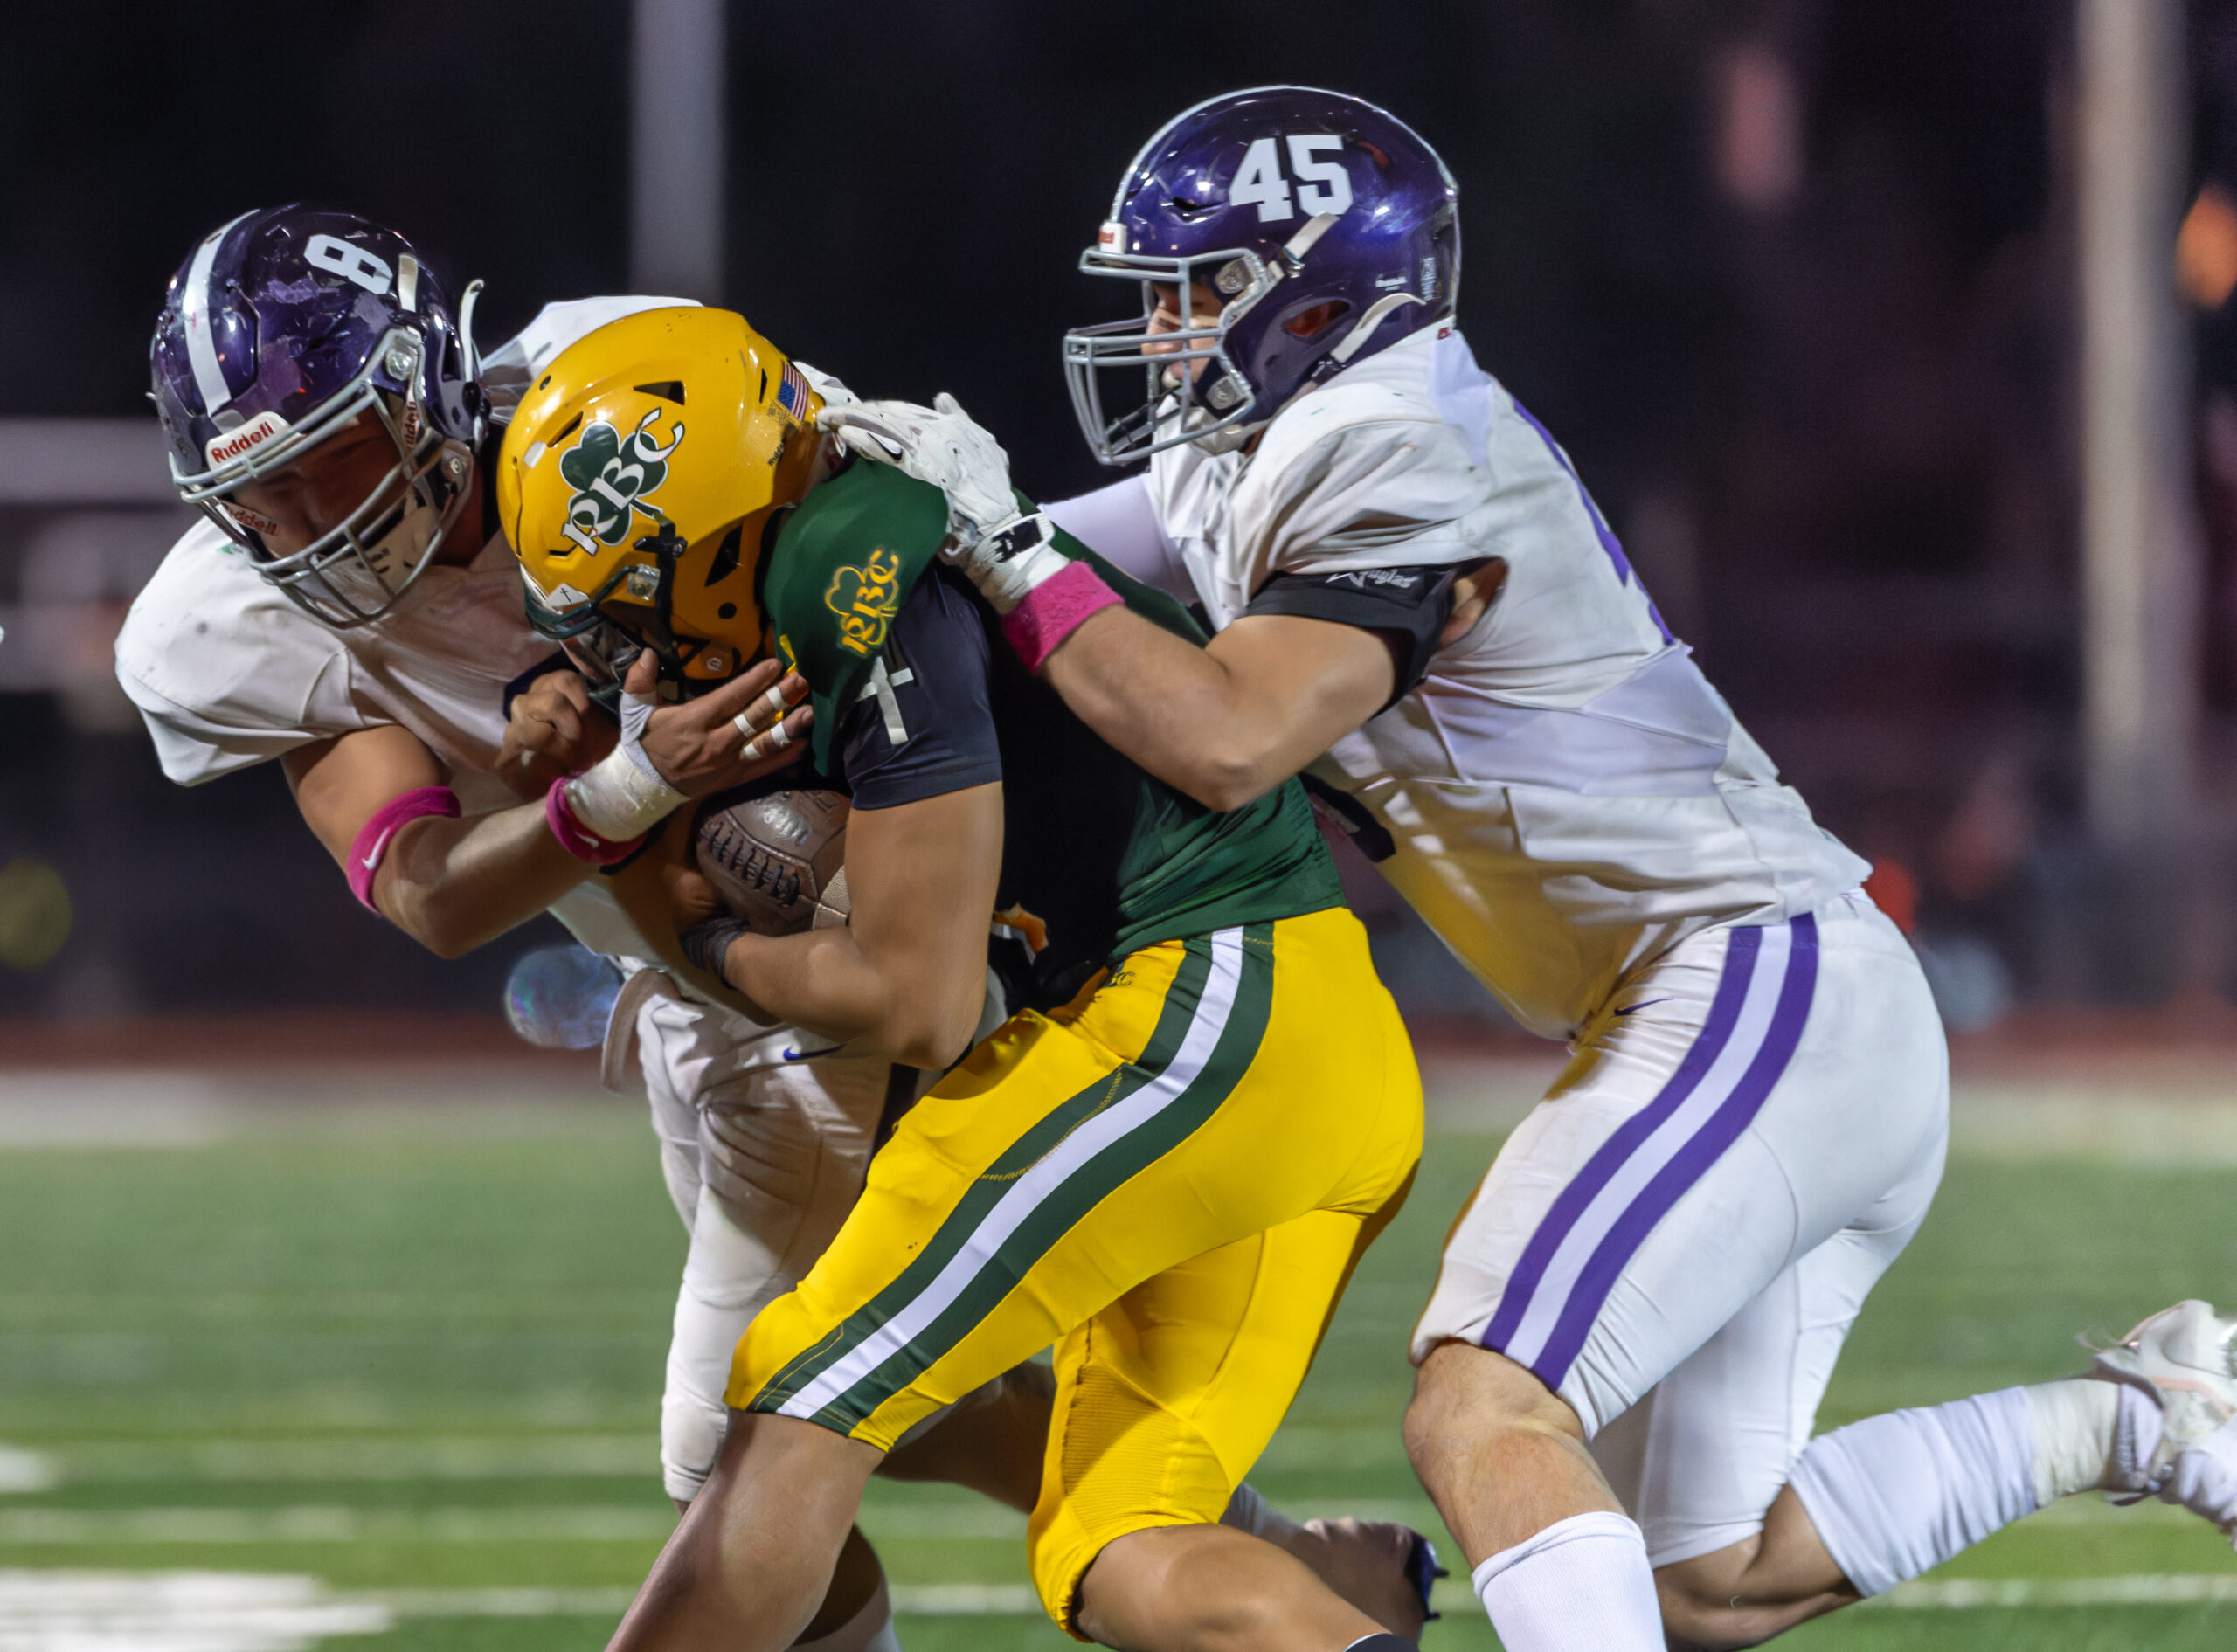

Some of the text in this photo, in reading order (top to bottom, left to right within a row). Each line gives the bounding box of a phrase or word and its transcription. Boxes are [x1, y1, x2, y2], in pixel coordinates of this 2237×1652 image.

[1229, 134, 1354, 223] 45
[303, 233, 393, 295] 8
[210, 419, 275, 464] Riddell
[560, 405, 686, 557] RBC
[841, 548, 900, 655] RBC
